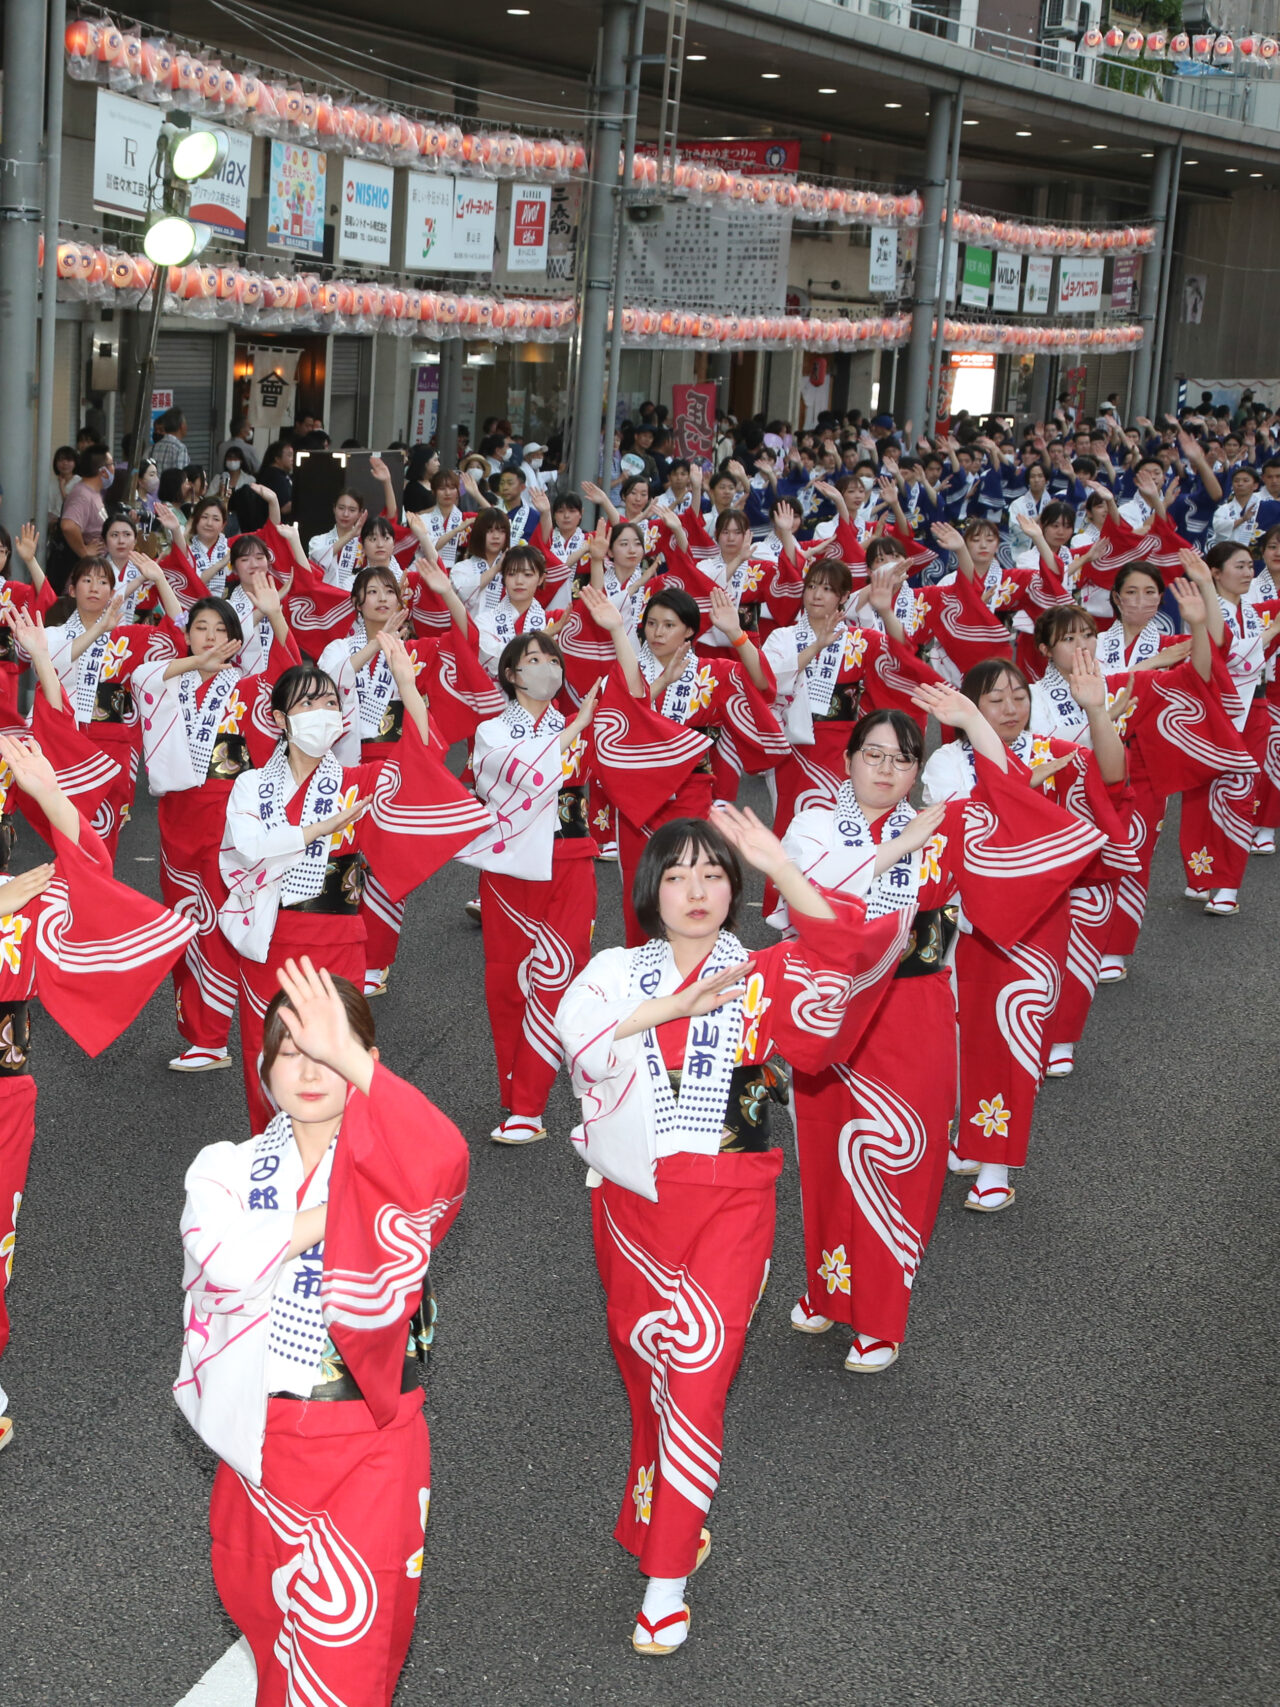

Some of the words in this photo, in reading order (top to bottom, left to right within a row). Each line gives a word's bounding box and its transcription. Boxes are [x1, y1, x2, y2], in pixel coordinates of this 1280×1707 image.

[356, 182, 389, 209] NISHIO
[997, 266, 1019, 286] WILD-1
[1068, 279, 1099, 297] ヨークベニマル
[84, 648, 104, 686] 郡山市
[820, 642, 840, 679] 郡山市
[196, 697, 222, 744] 郡山市
[688, 1003, 724, 1080] 山市
